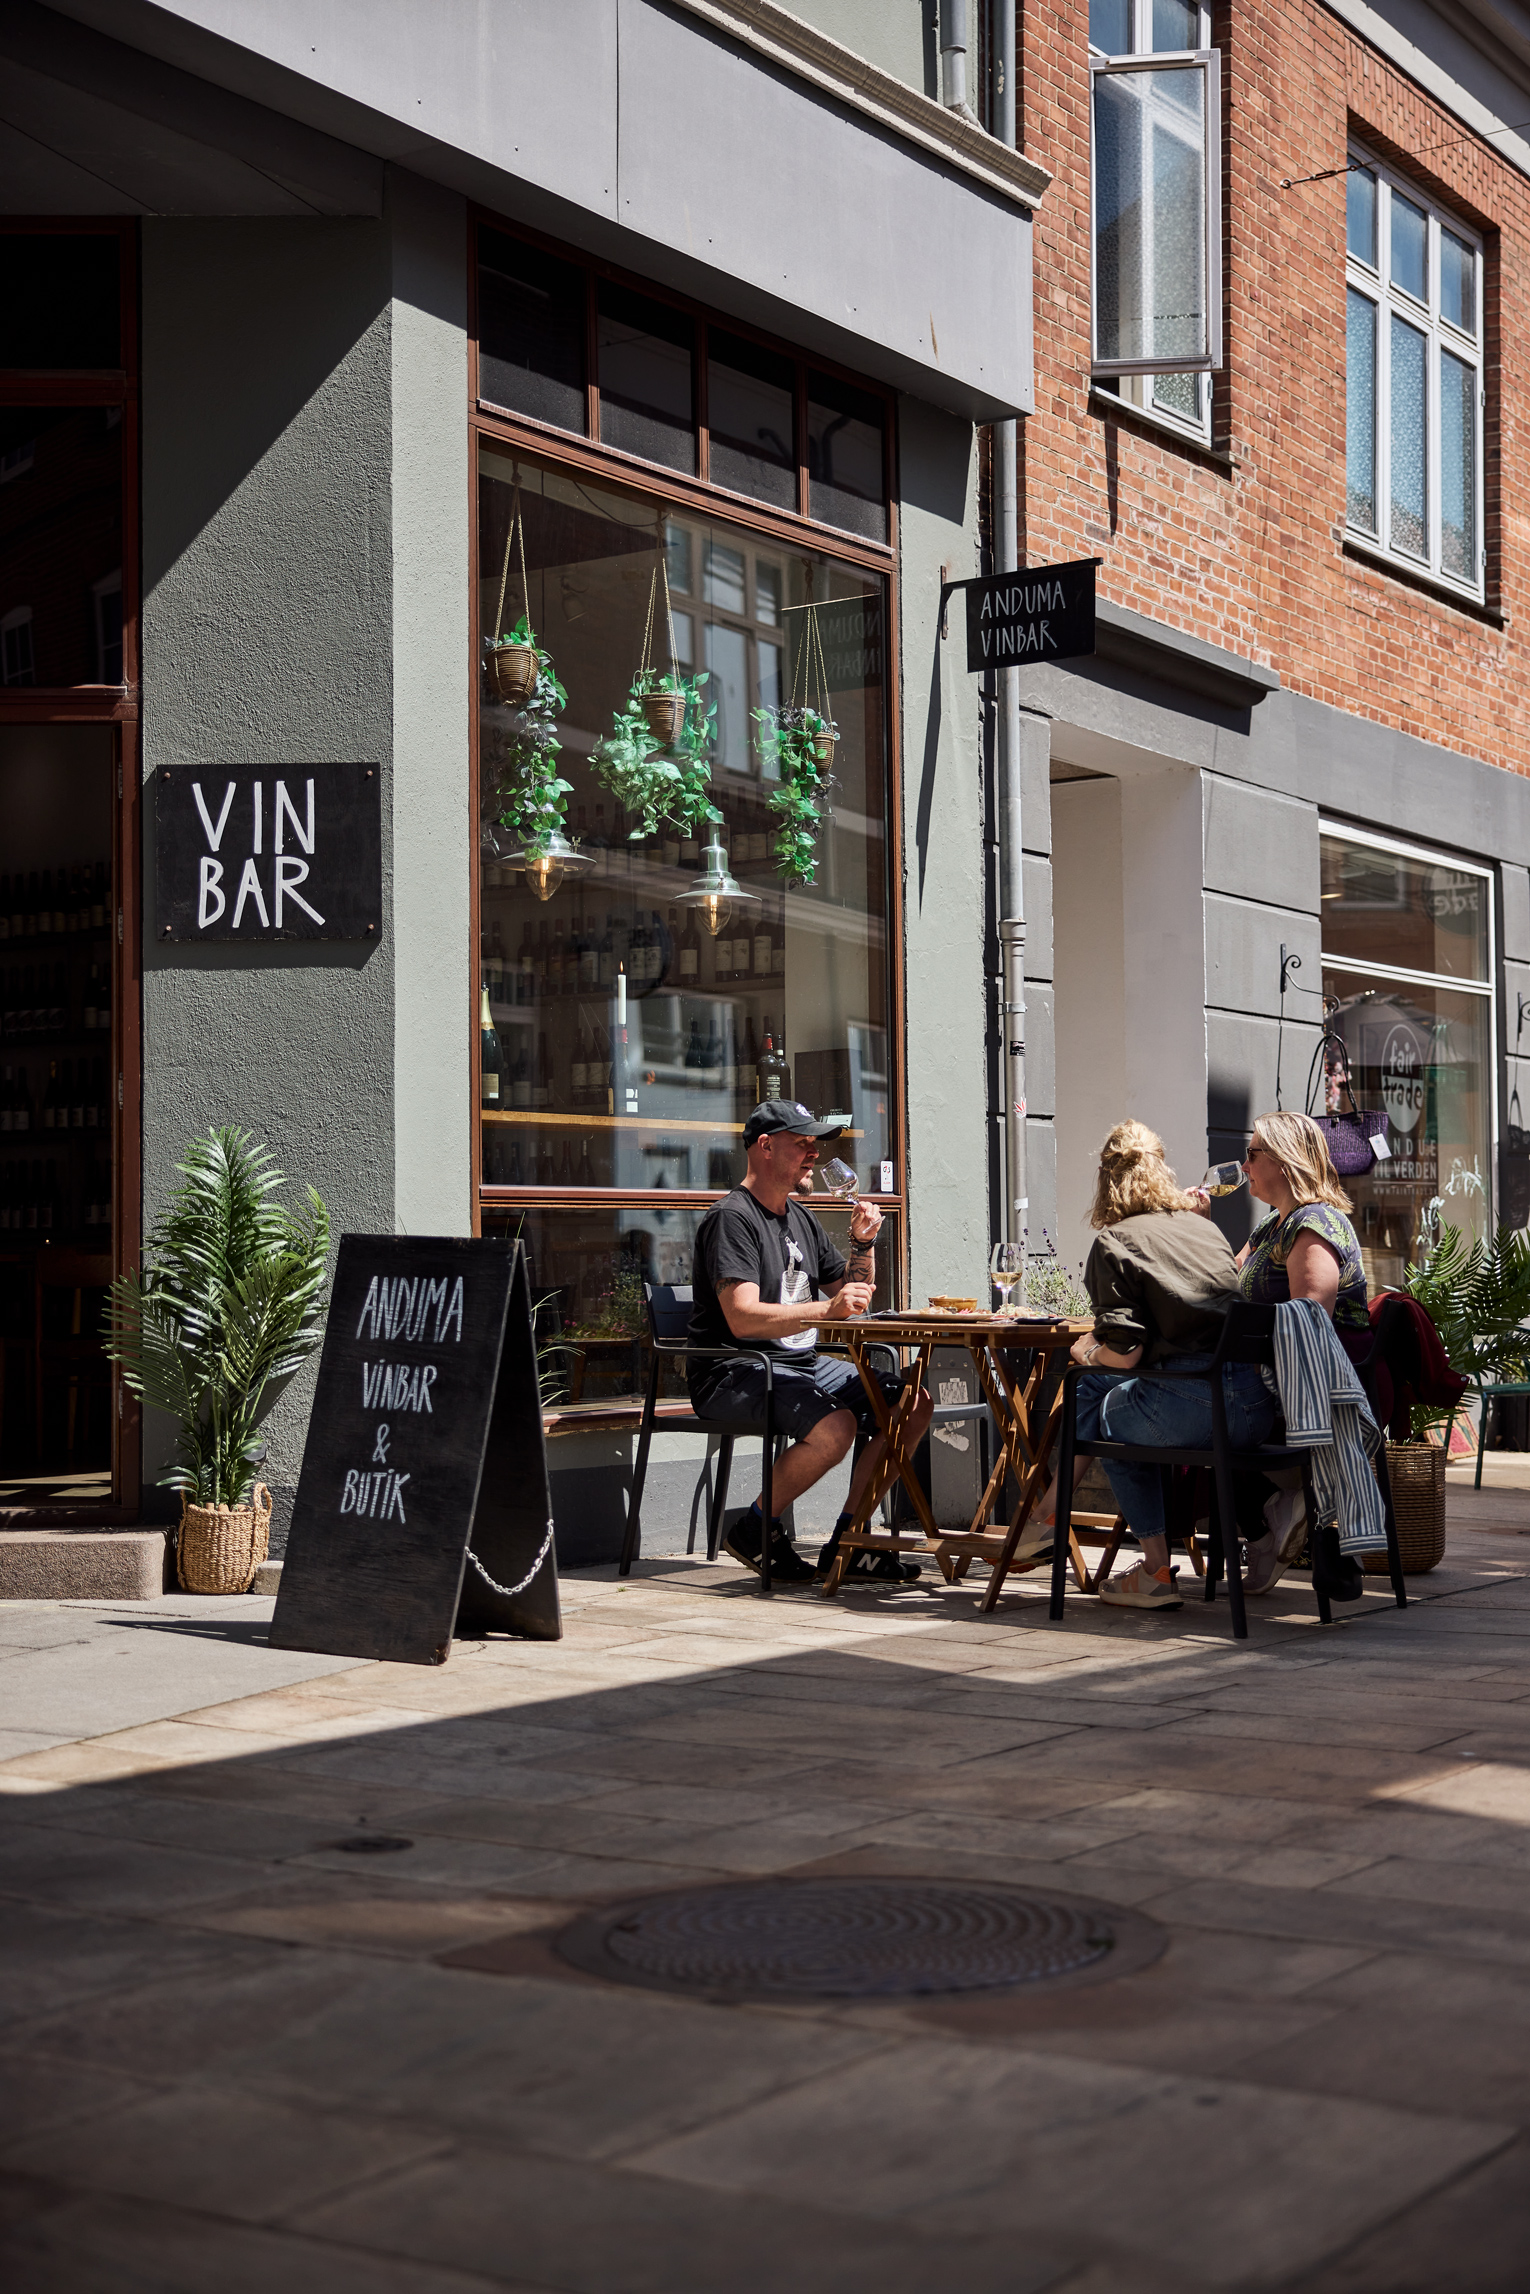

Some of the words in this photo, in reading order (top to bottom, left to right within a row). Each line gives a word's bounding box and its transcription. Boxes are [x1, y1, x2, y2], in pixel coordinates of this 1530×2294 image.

[980, 580, 1066, 620] ANDUMA
[980, 620, 1058, 658] VINBAR
[191, 778, 315, 855] VIN
[198, 856, 326, 929] BAR
[1389, 1040, 1416, 1075] fair
[1382, 1076, 1423, 1110] trade
[1393, 1137, 1437, 1157] NDUE
[1393, 1161, 1437, 1179] VERDEN
[356, 1275, 464, 1343] ANDUMA
[363, 1359, 437, 1413] VINBAR
[372, 1423, 391, 1464] &
[340, 1468, 411, 1525] BUTIK
[857, 1553, 881, 1572] N
